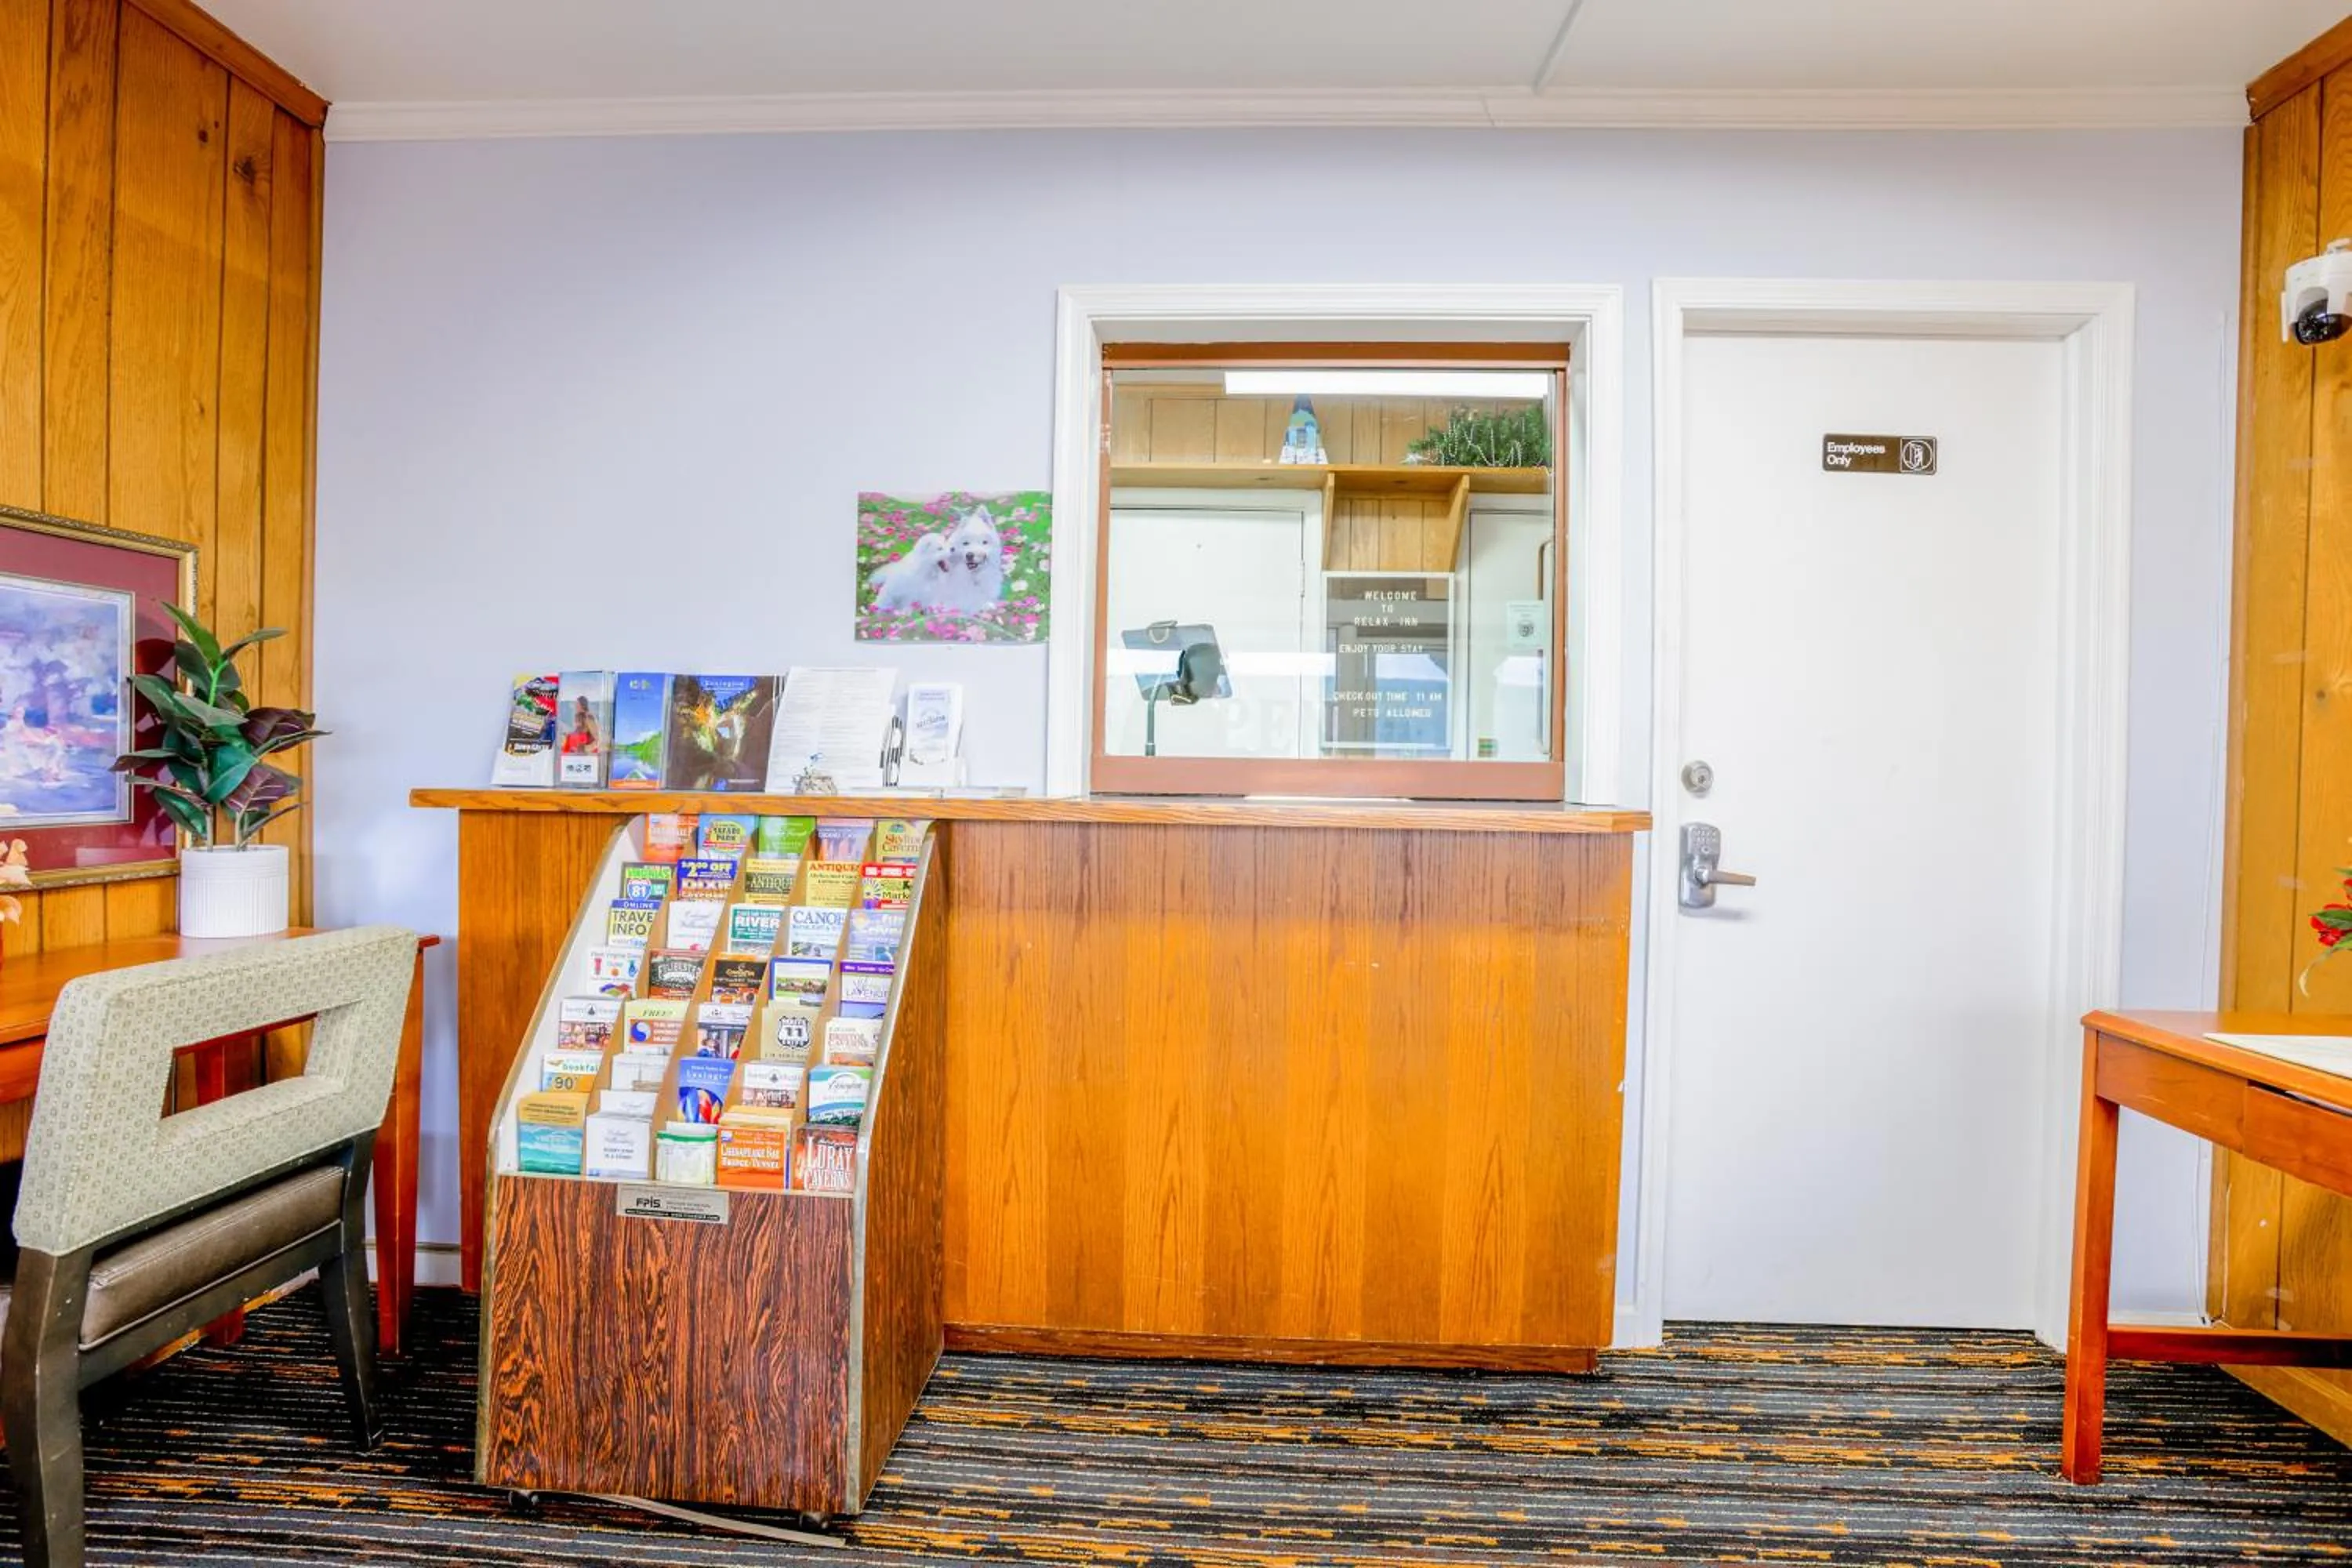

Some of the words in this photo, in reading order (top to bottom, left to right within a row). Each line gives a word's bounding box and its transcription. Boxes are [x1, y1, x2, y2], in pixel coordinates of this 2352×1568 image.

[1827, 441, 1886, 456] Employees
[1827, 454, 1852, 466] Only
[1364, 590, 1417, 601] WELCOME
[1381, 604, 1393, 613] TO
[1354, 616, 1388, 626] RELAX
[1399, 617, 1418, 626] INN
[1338, 644, 1370, 654] ENJOY
[1373, 644, 1396, 654] YOUR
[1400, 644, 1424, 653] STAY
[1333, 691, 1363, 702] CHECK
[1366, 691, 1382, 701] OUT
[1386, 691, 1407, 701] TIME
[1353, 708, 1380, 718] PETS
[1385, 708, 1432, 718] ALLOWED
[710, 862, 732, 873] OFF
[632, 885, 646, 898] 81
[735, 915, 780, 929] RIVER
[612, 924, 648, 936] INFO
[786, 1027, 804, 1037] 11
